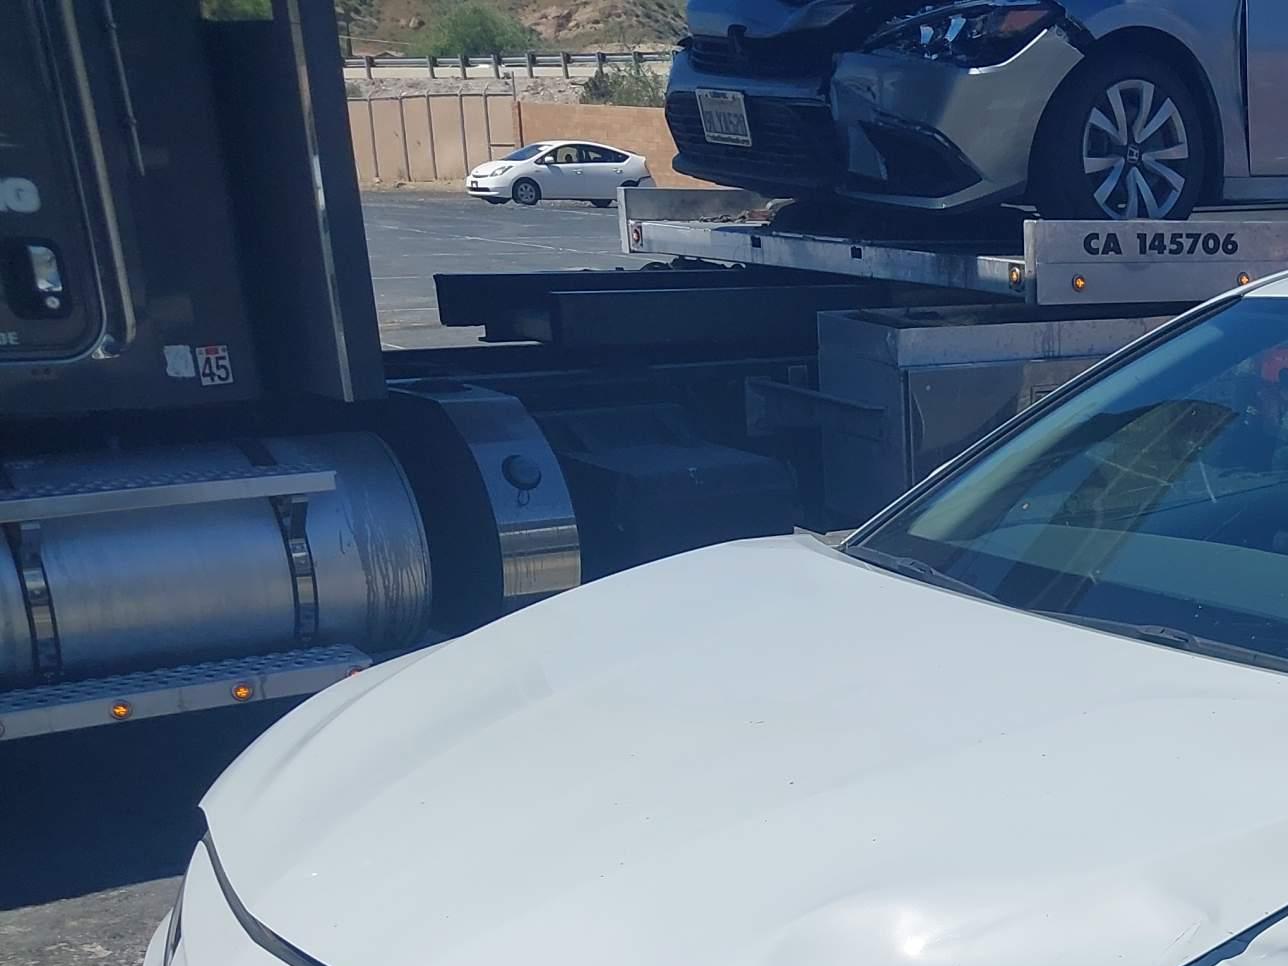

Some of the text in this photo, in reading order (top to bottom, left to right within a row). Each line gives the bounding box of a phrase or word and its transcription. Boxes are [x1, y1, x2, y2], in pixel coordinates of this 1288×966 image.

[1083, 232, 1239, 255] CA 145706
[202, 356, 229, 382] 45
